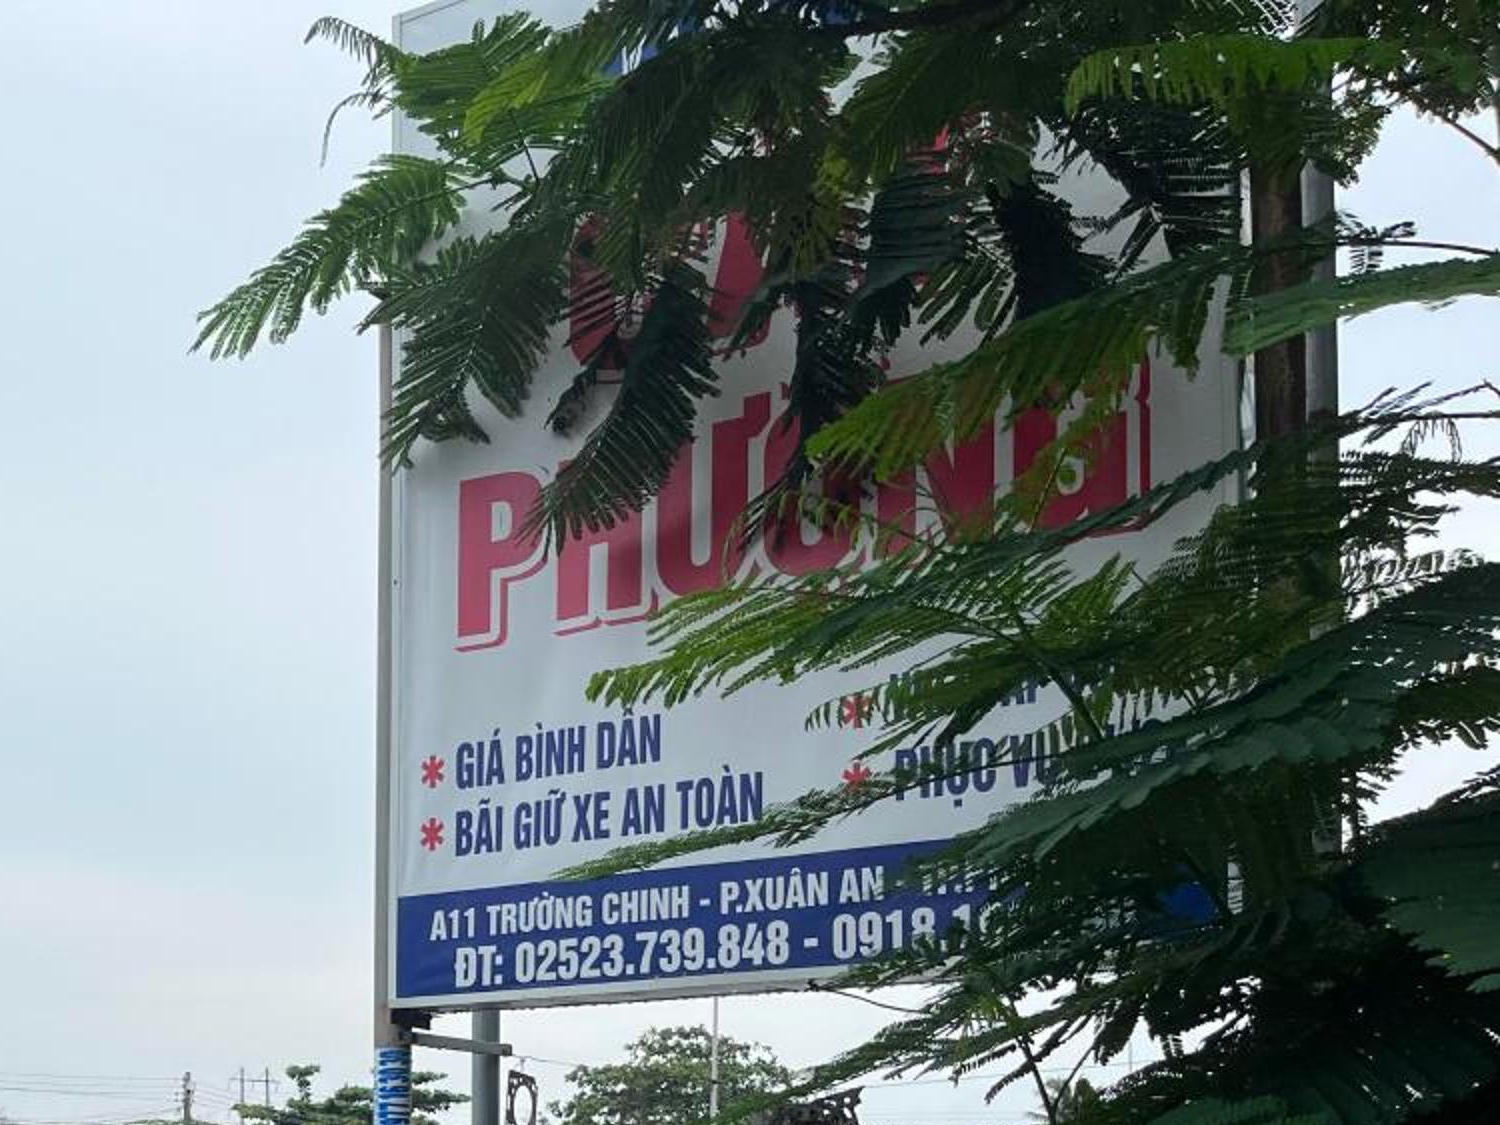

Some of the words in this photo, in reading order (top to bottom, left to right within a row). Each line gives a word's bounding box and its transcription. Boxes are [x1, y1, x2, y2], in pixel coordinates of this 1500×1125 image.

[455, 727, 505, 790] GIÁ
[515, 721, 587, 783] BÌNH
[596, 708, 662, 769] DÂN
[895, 737, 997, 809] PHỤC
[455, 798, 503, 857] BÃI
[513, 788, 569, 851] GIỮ
[571, 790, 611, 843] XE
[621, 783, 666, 836] AN
[676, 765, 764, 829] TOÀN
[430, 908, 476, 942] A11
[486, 893, 593, 936] TRƯỜNG
[601, 885, 690, 924] CHINH
[719, 867, 829, 916] P.XUÂN
[839, 865, 885, 904] AN
[454, 944, 503, 988] ĐT:
[514, 920, 790, 982] 02523.739.848
